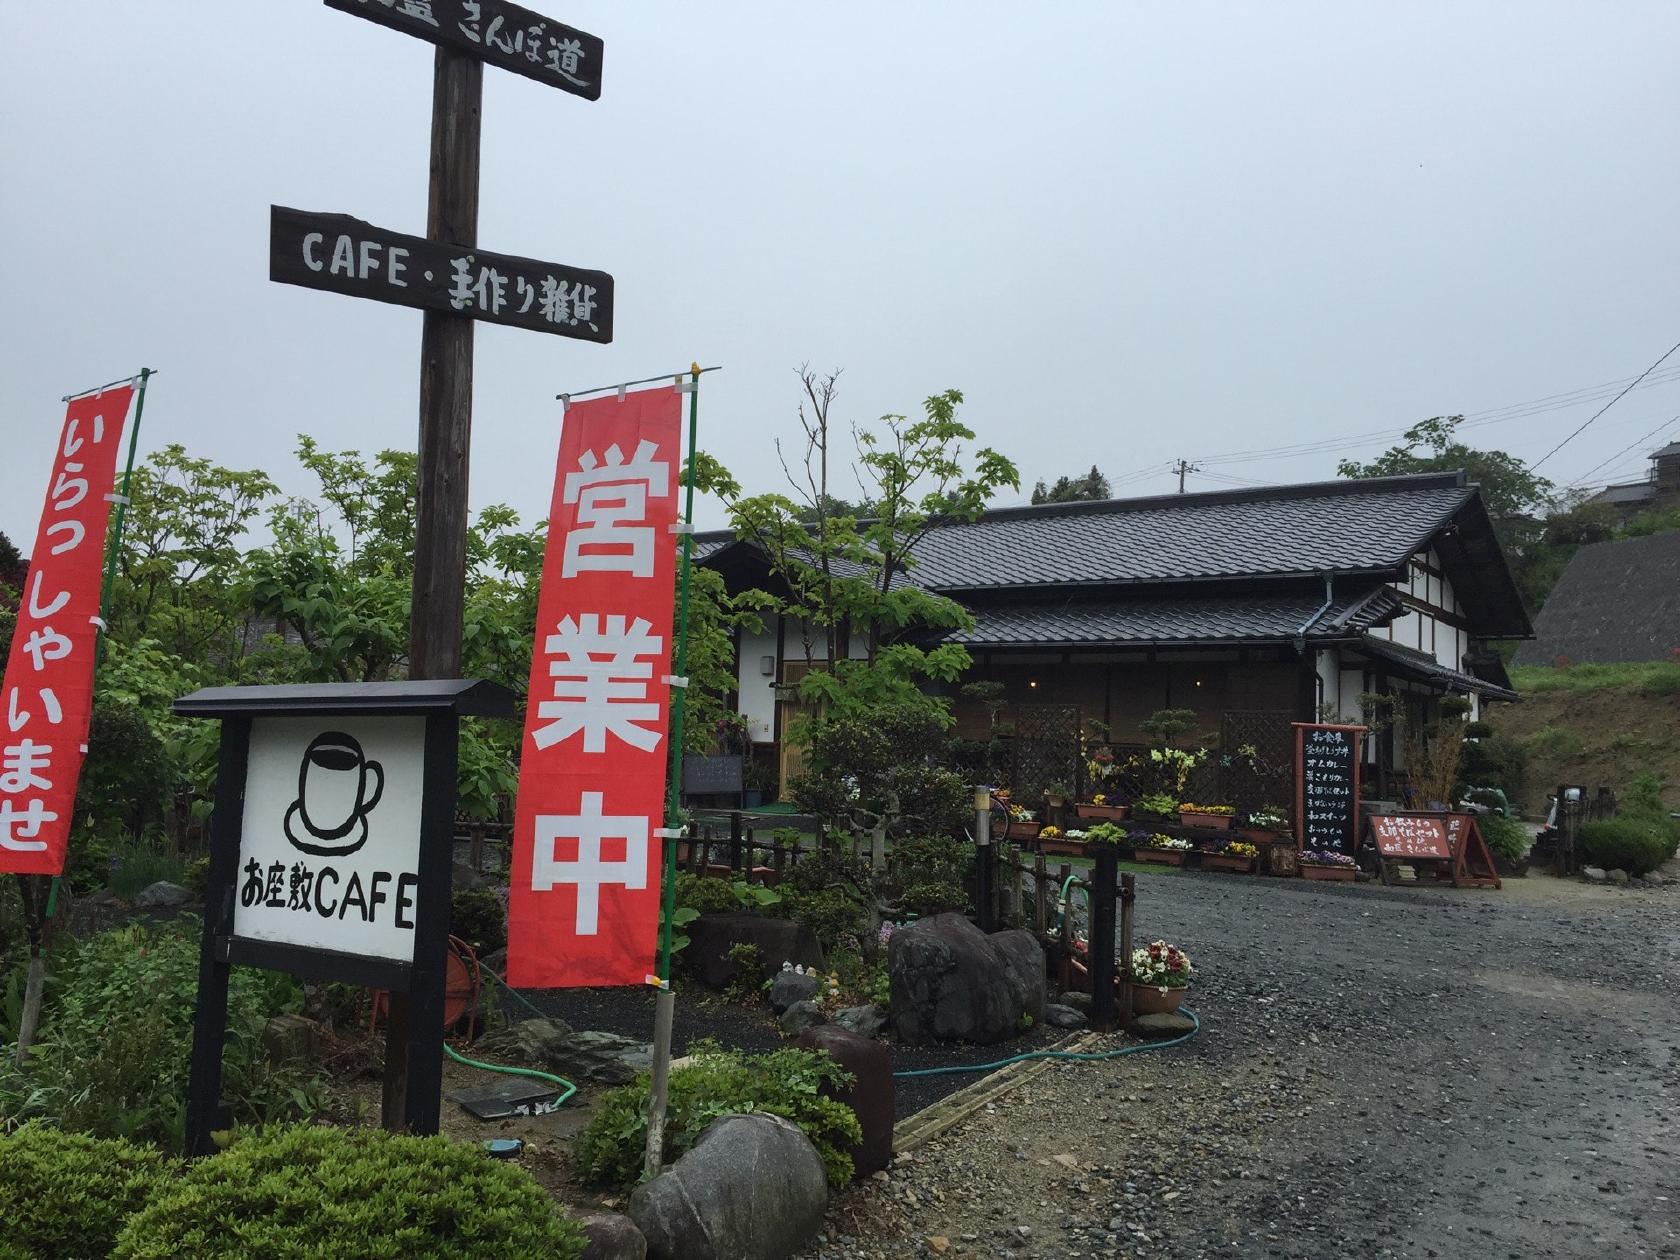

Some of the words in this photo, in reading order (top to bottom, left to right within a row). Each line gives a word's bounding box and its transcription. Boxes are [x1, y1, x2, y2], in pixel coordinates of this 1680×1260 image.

[0, 414, 105, 852] いらっしゃいませ
[531, 439, 669, 936] 営業中
